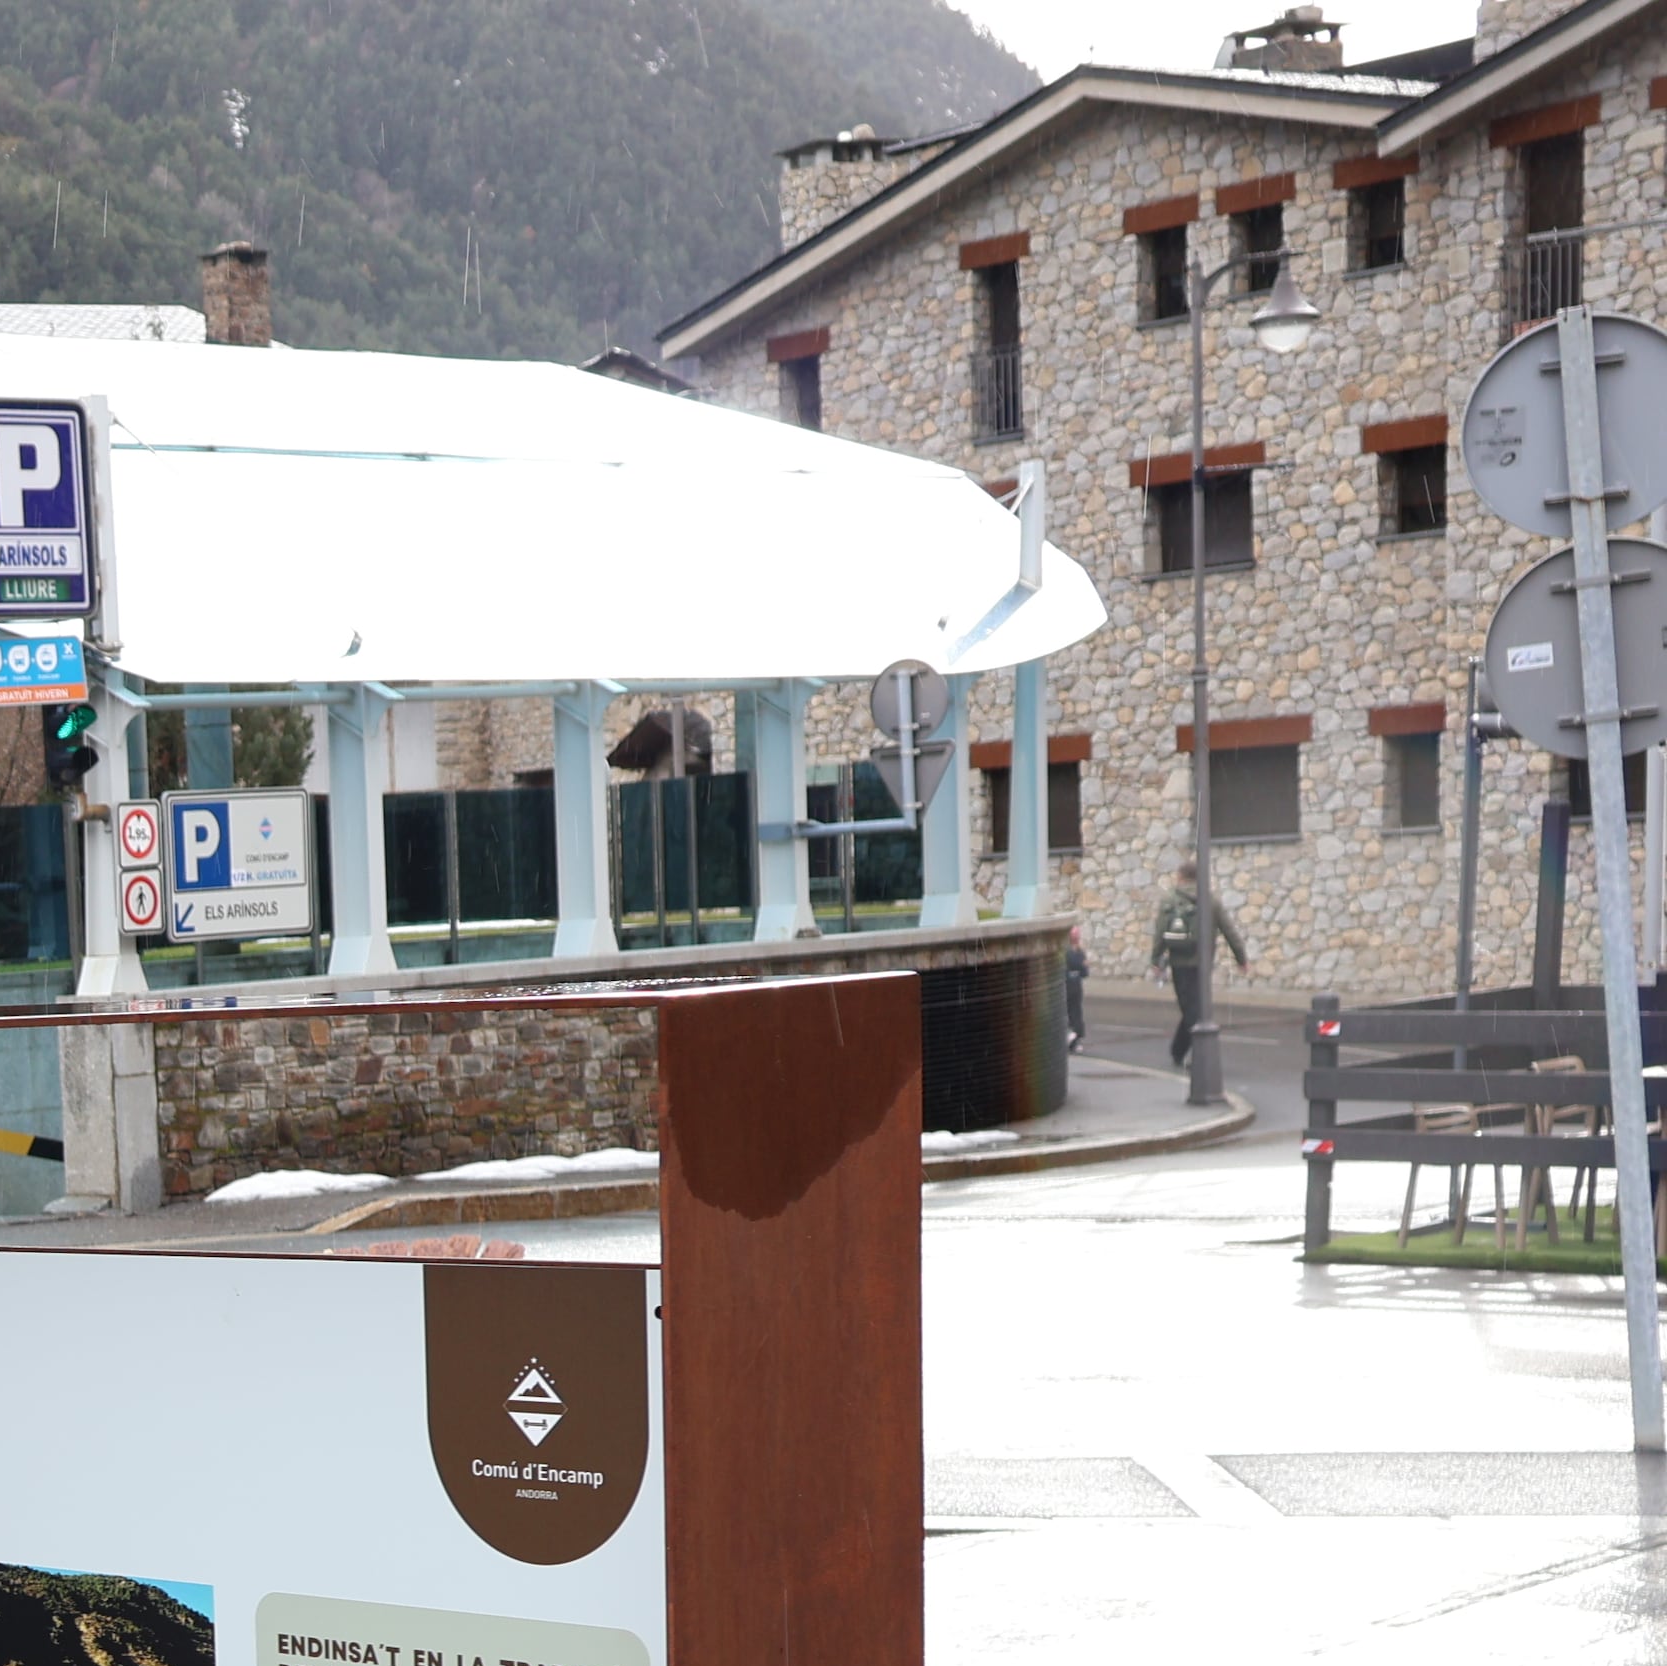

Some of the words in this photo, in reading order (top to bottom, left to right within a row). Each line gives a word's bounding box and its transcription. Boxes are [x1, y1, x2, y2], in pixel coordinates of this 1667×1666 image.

[5, 579, 58, 599] LLIURE
[35, 687, 69, 700] HIVERN
[182, 809, 220, 883] P
[205, 904, 224, 920] ELS
[227, 899, 278, 919] ARÍNSOLS
[472, 1459, 518, 1479] Comú
[523, 1463, 603, 1489] d'Encamp
[515, 1489, 558, 1500] ANDORRA
